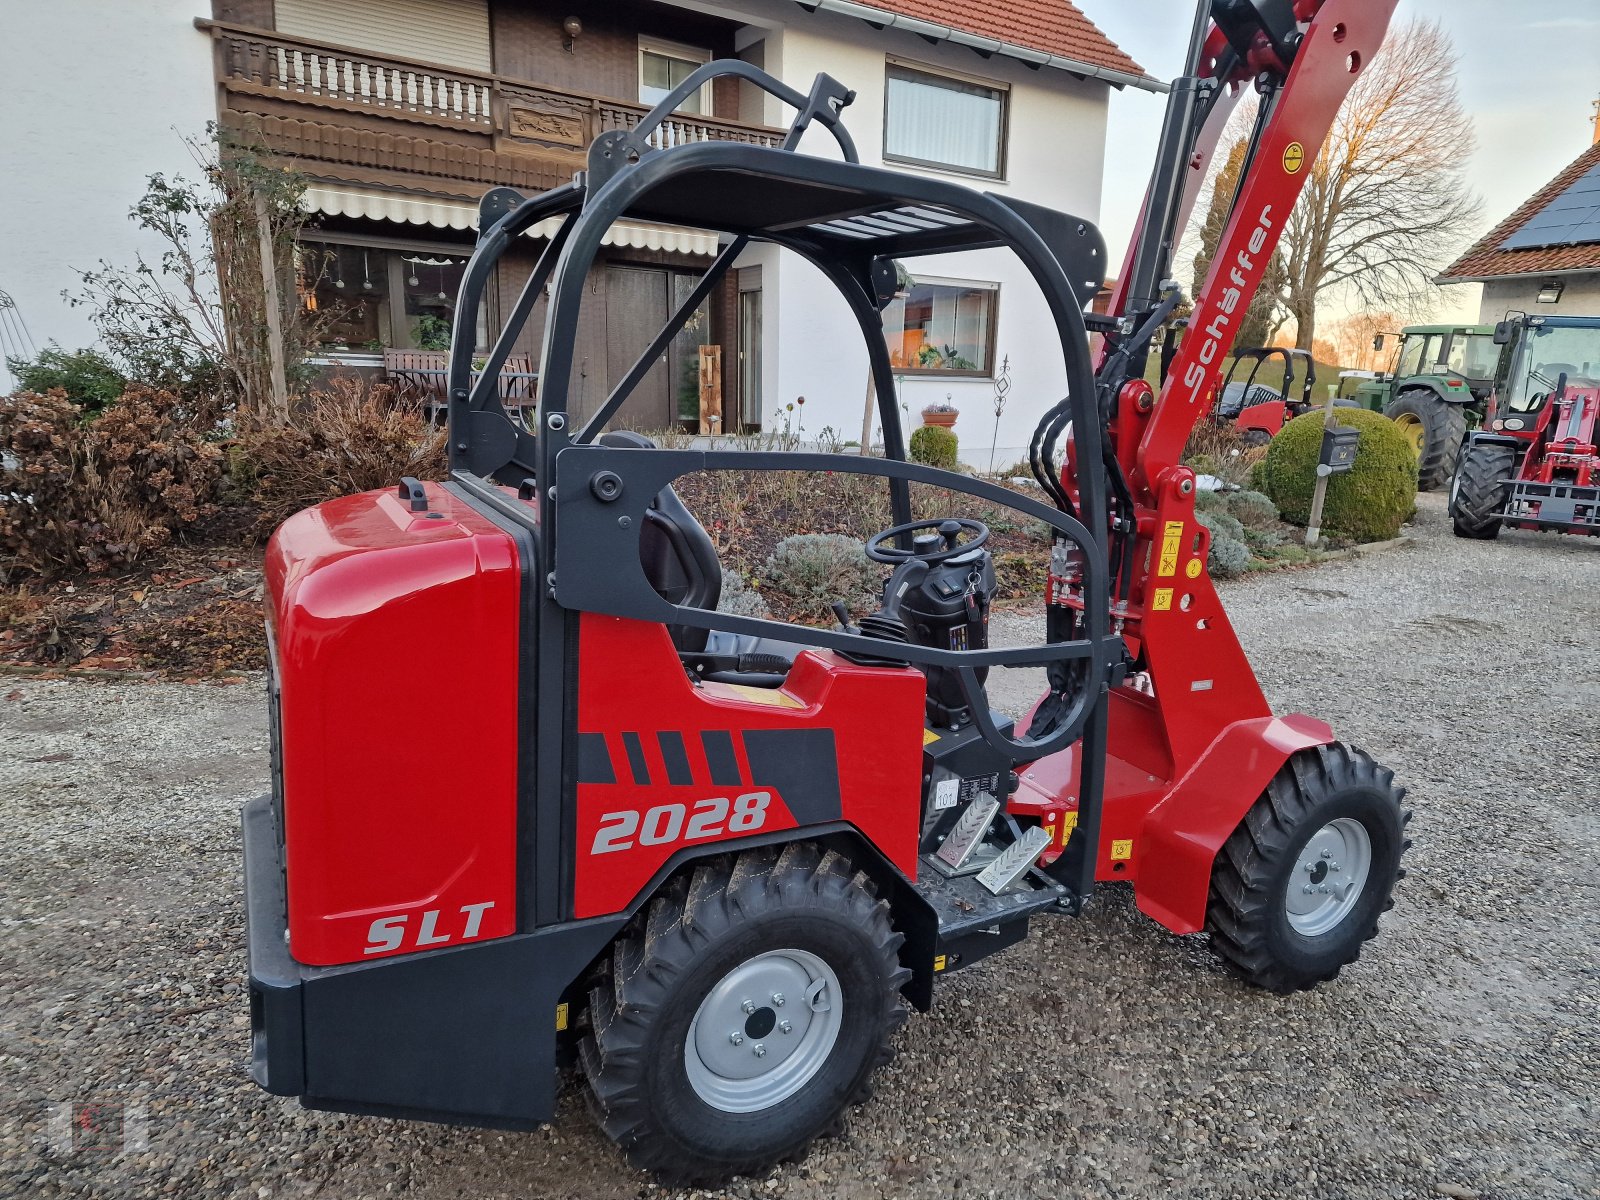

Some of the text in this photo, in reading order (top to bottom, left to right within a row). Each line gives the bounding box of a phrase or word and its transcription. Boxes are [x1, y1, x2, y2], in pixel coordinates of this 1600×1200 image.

[1184, 204, 1273, 404] Schäffer
[590, 791, 771, 855] 2028
[363, 901, 495, 954] SLT
